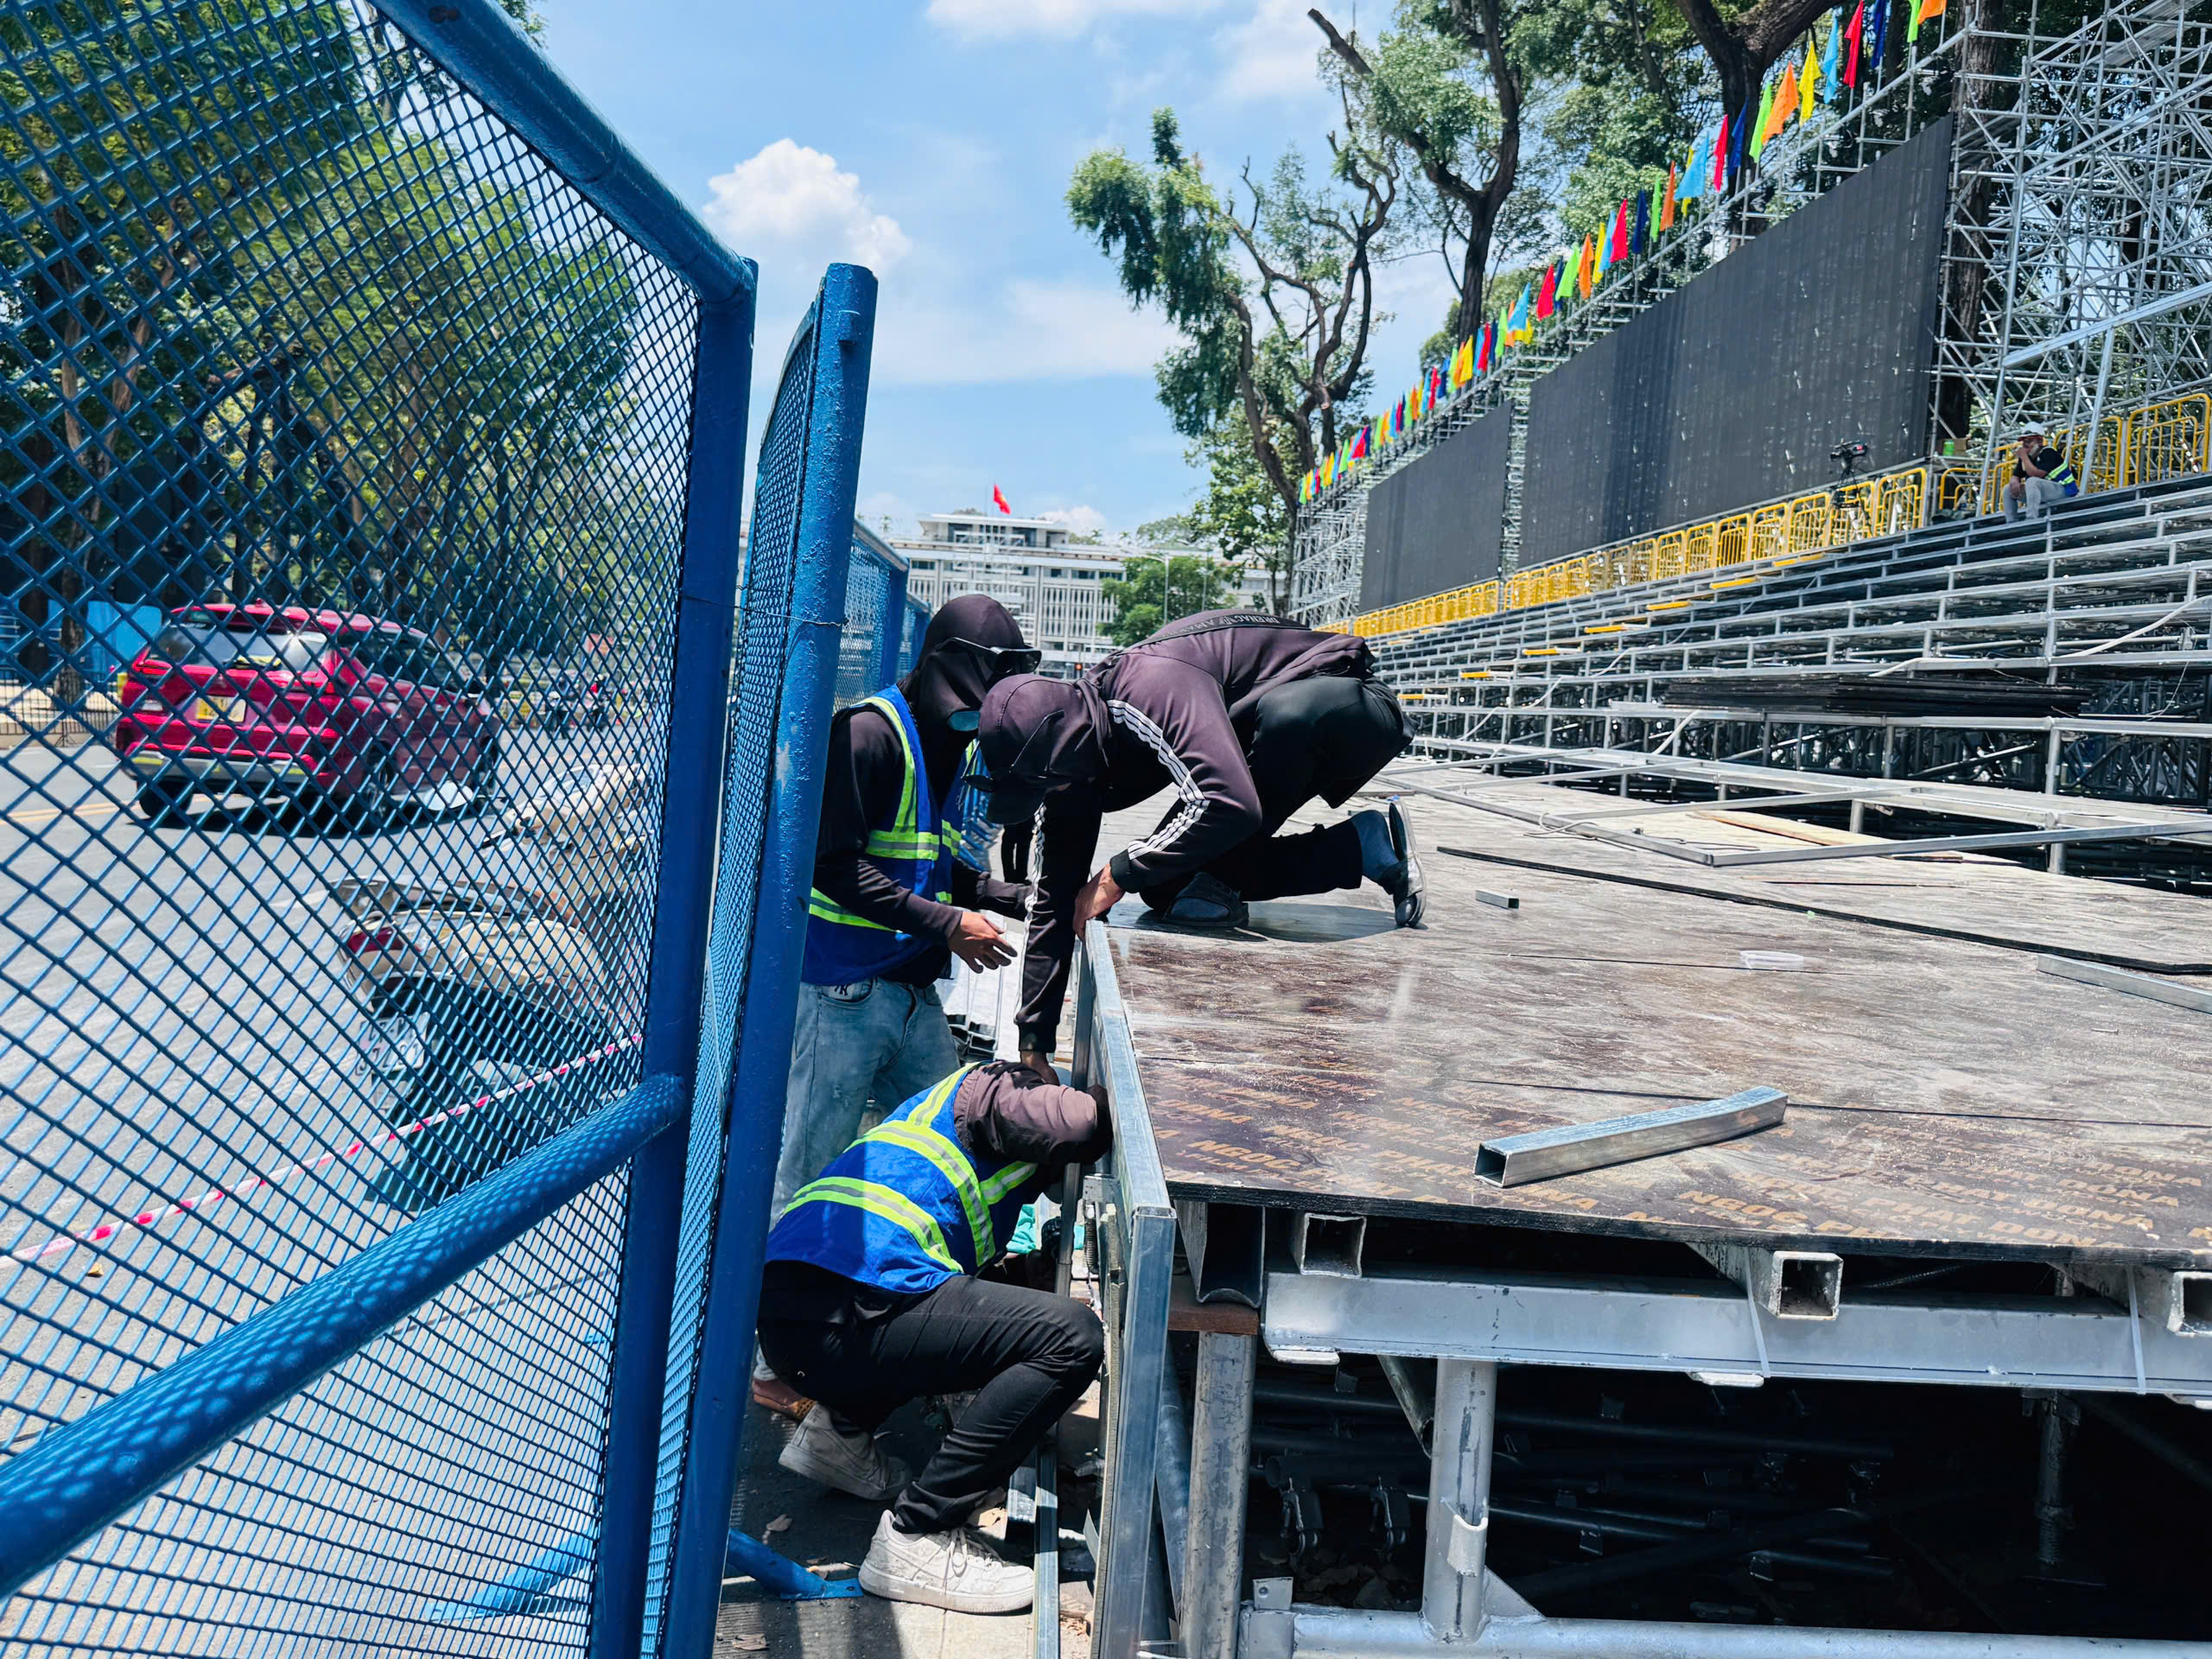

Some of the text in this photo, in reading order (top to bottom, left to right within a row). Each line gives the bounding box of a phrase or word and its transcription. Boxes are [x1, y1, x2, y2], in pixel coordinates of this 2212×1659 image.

[1187, 1139, 1301, 1170] NGOC
[1678, 1190, 1809, 1224] NGOC
[2056, 1178, 2179, 1208] DONA
[2024, 1198, 2154, 1231] DONA
